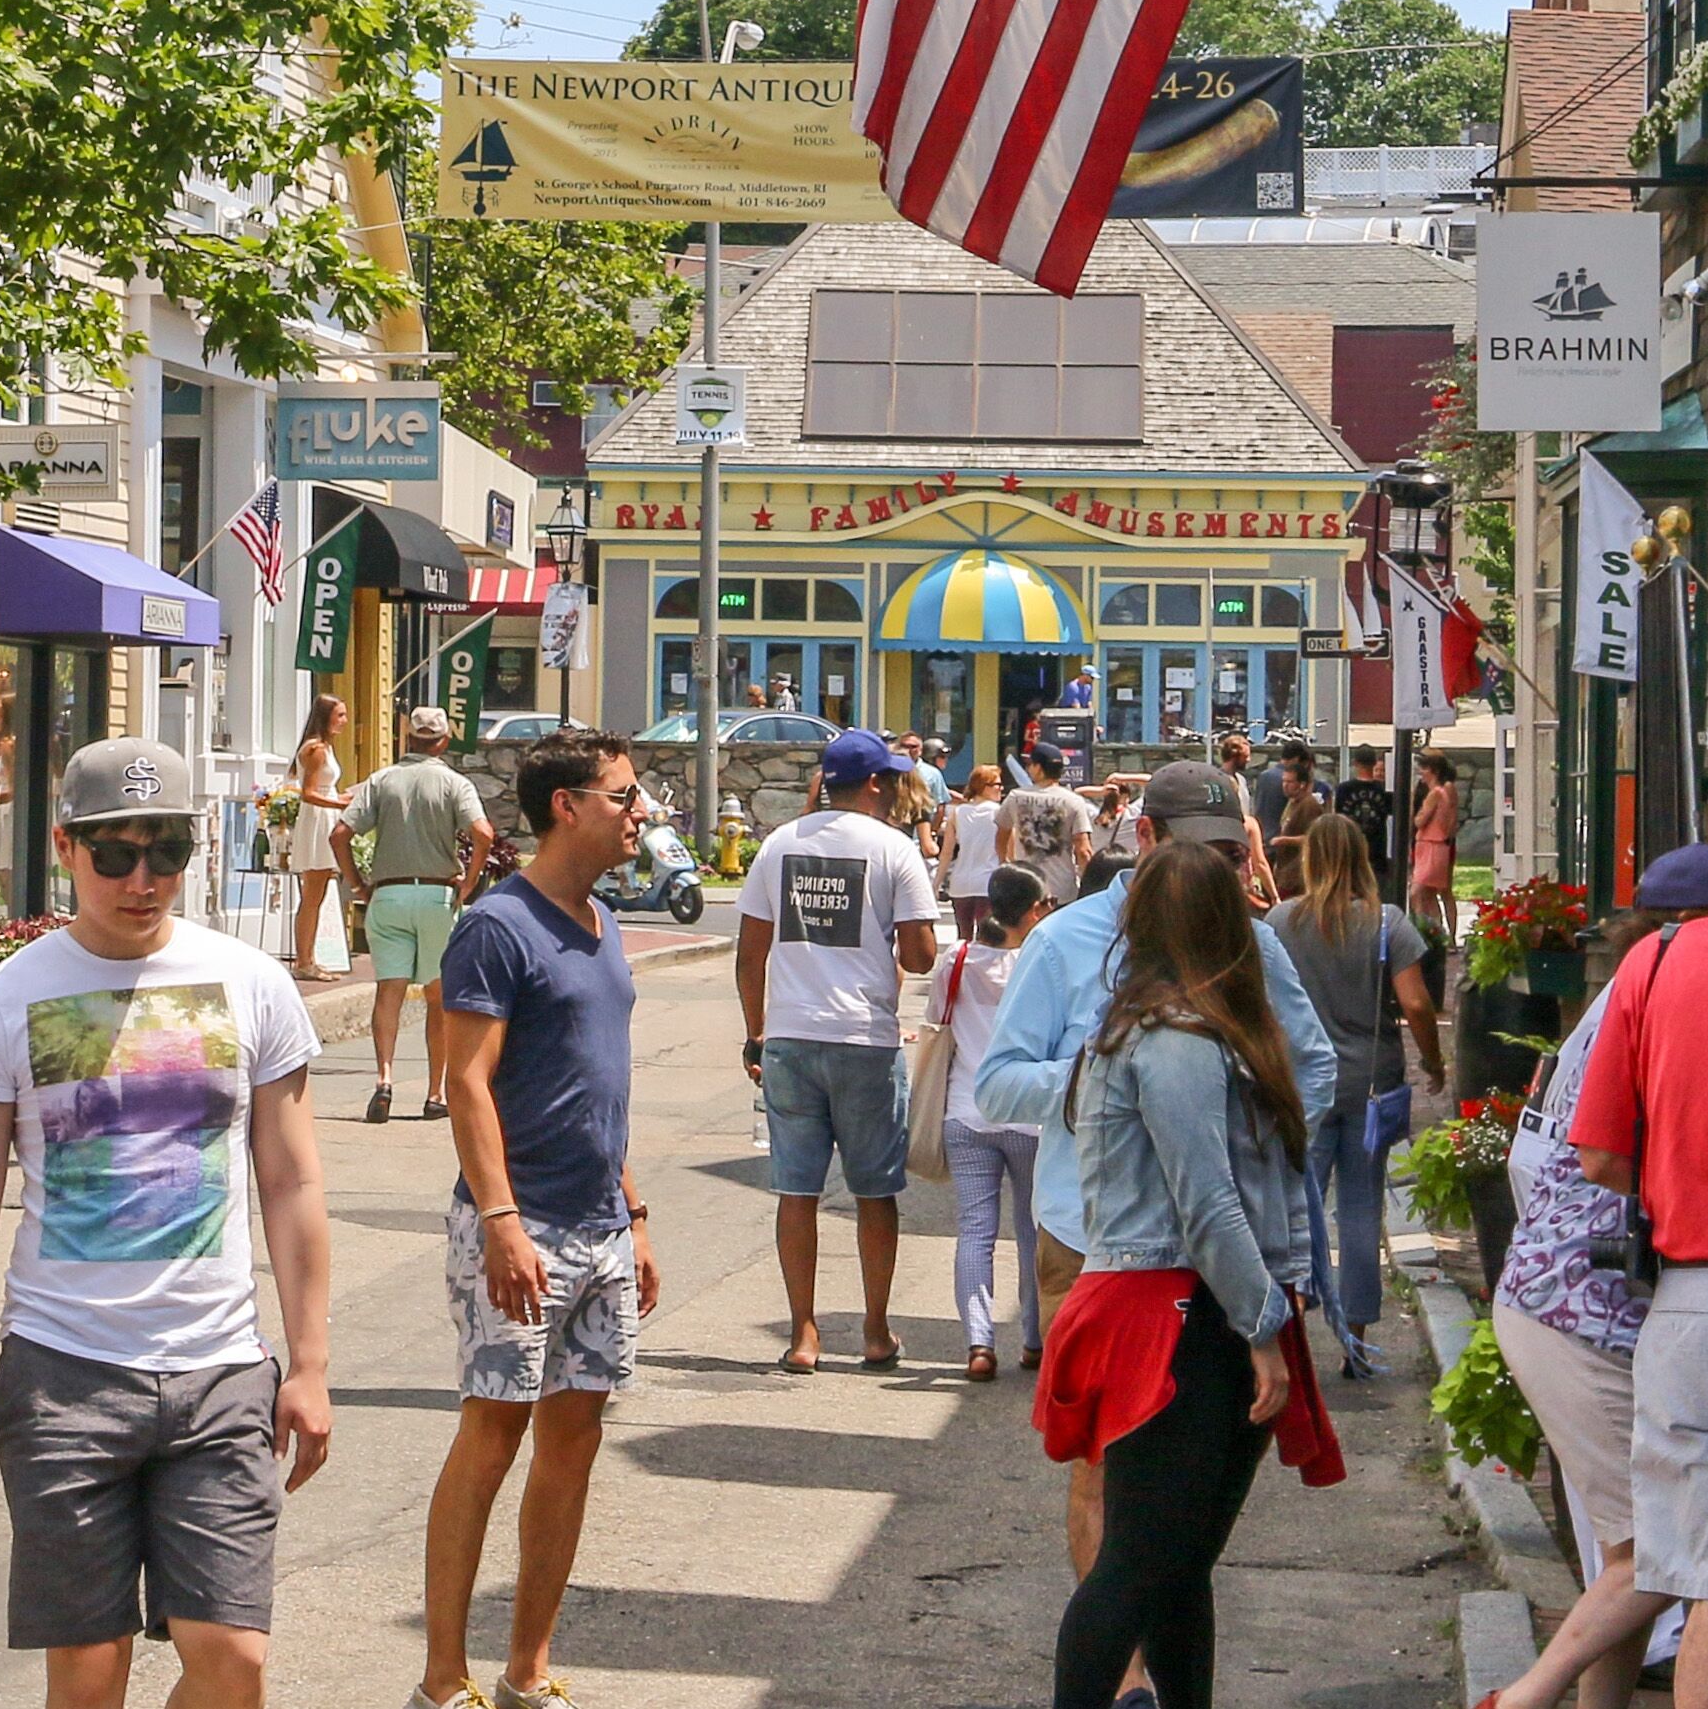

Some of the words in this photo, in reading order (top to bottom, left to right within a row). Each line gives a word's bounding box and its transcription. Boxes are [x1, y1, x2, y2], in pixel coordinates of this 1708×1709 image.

[450, 70, 518, 99] THE
[531, 73, 698, 101] NEWPORT
[1151, 71, 1236, 100] 4-26
[645, 180, 701, 193] Purgatory
[1490, 337, 1648, 361] BRAHMIN
[691, 391, 729, 400] TENNIS
[616, 503, 702, 530] RYA
[809, 470, 958, 532] FAMILY
[1054, 489, 1341, 538] AMUSEMENTS
[309, 557, 342, 659] OPEN
[720, 594, 745, 606] ATM
[1218, 602, 1245, 613] ATM
[1597, 550, 1631, 671] SALE
[1308, 638, 1333, 651] ONE
[1417, 616, 1430, 709] GAASTRA
[448, 650, 474, 742] OPEN
